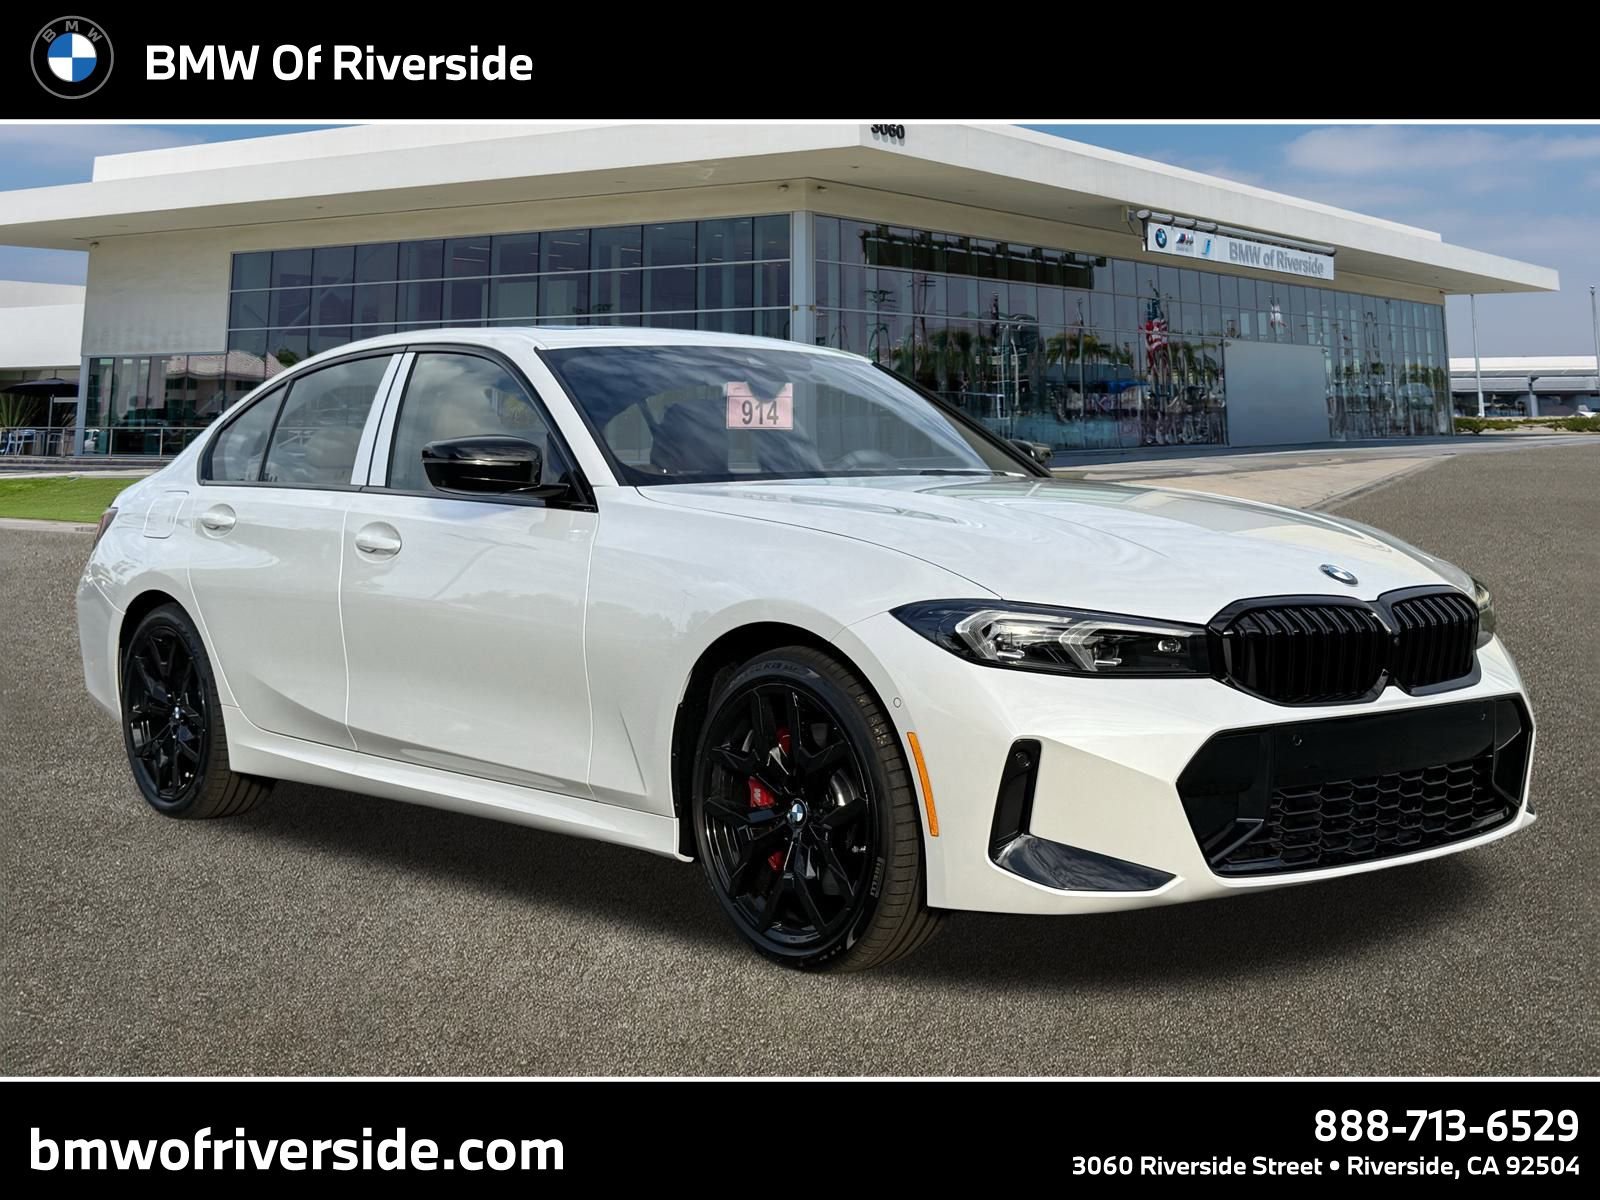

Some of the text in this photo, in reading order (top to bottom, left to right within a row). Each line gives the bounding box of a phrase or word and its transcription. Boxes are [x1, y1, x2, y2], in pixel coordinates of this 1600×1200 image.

[1229, 242, 1260, 265] BMW
[1263, 249, 1275, 267] of
[1276, 251, 1324, 274] Riverside
[742, 400, 779, 425] 914
